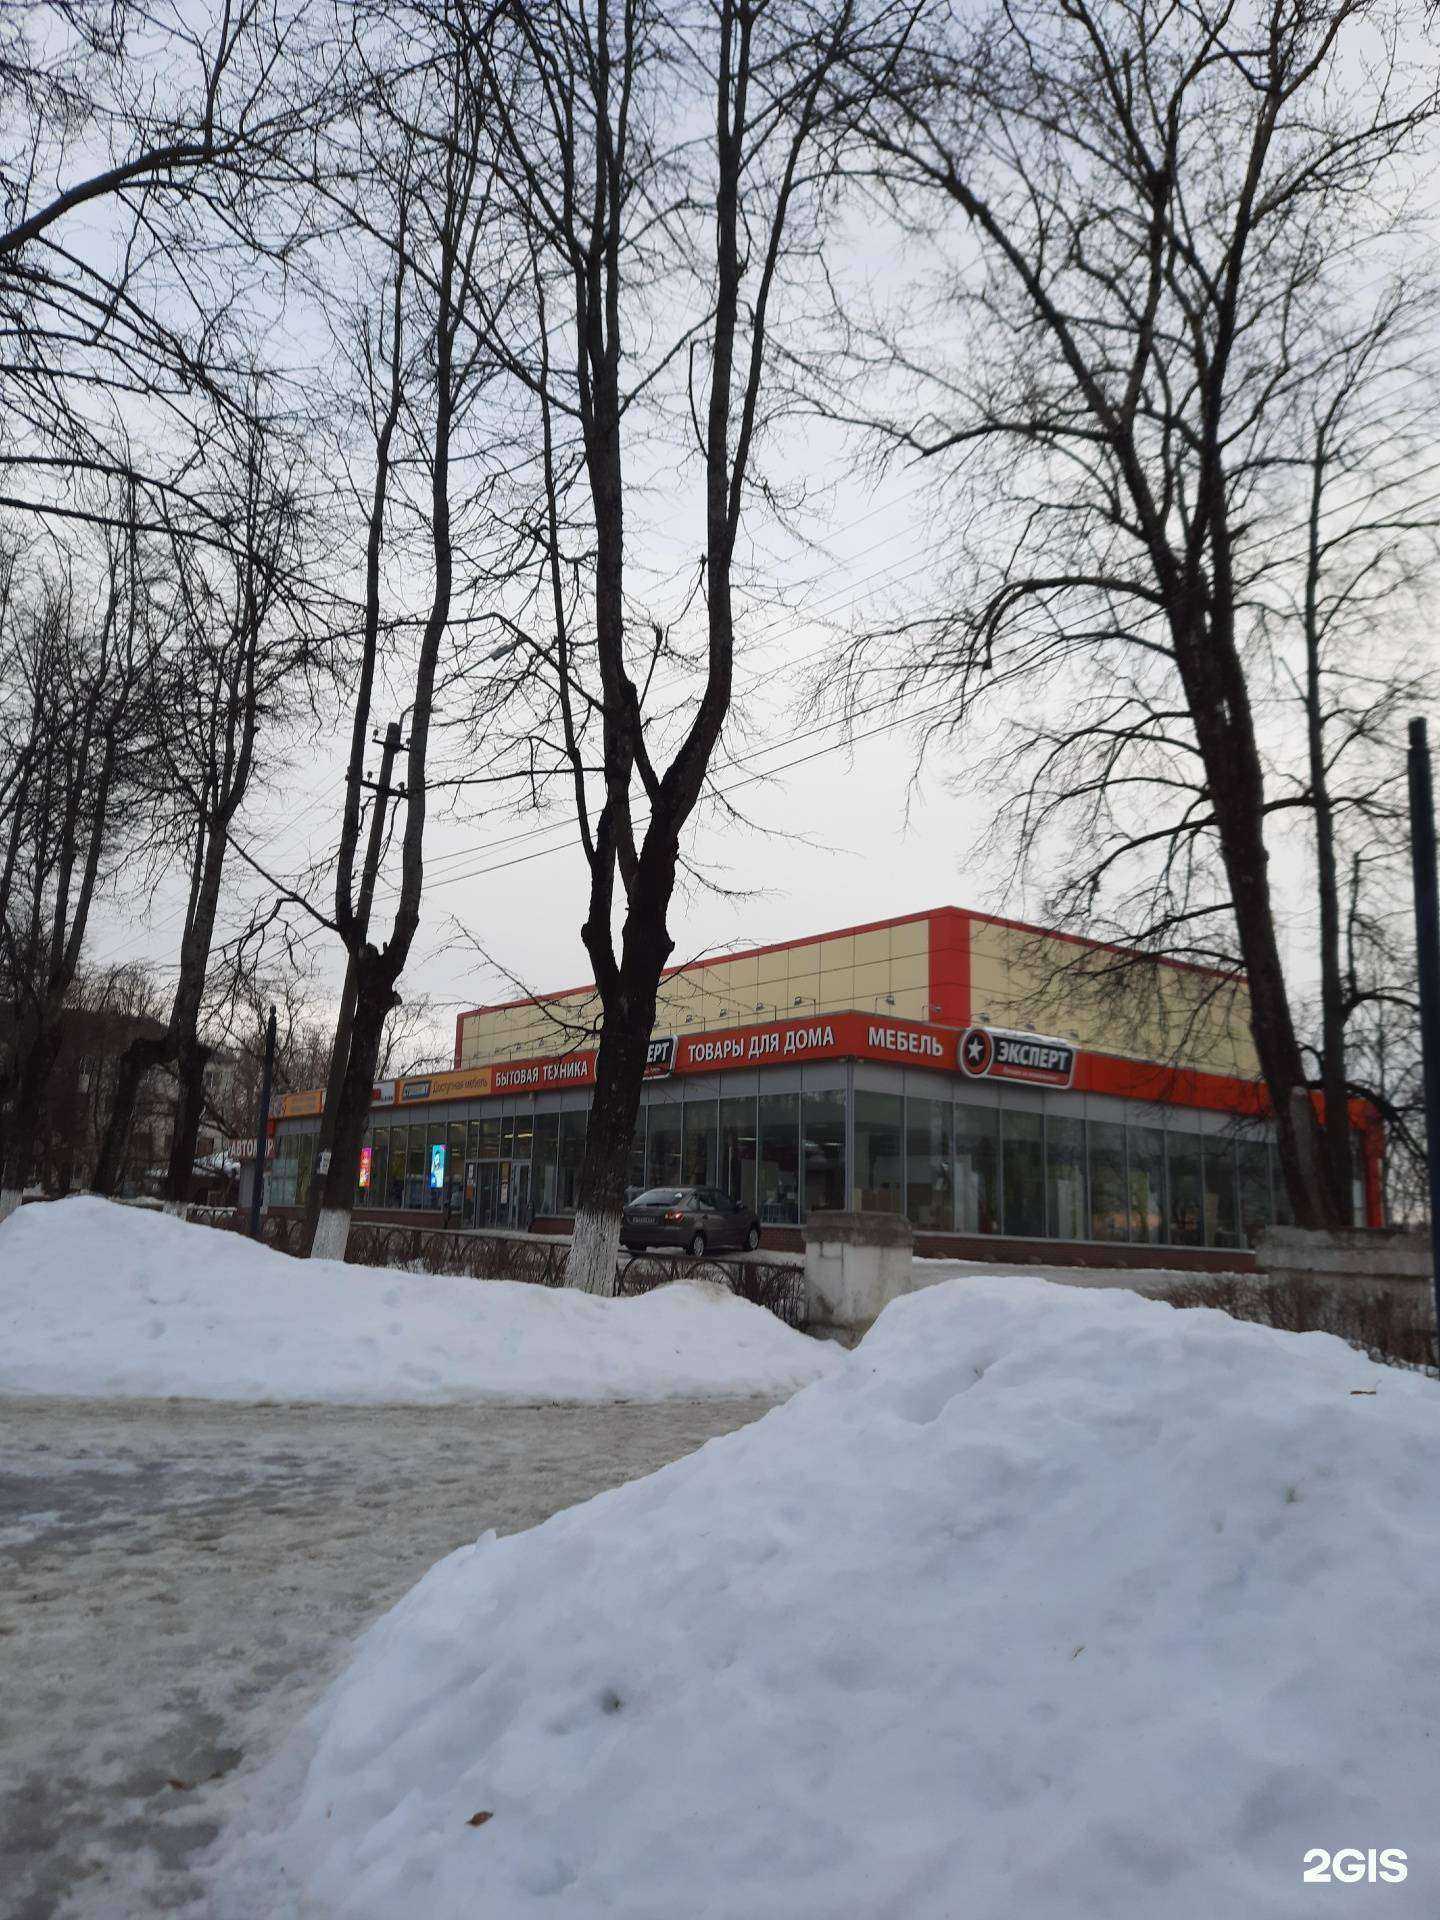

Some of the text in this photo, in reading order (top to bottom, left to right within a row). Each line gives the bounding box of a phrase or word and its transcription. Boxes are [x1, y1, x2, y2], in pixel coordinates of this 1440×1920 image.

[646, 1041, 670, 1063] ЕРТ
[688, 1025, 835, 1063] ТОВАРЫ ДЛЯ ДОМА
[868, 1026, 943, 1057] МЕБЕЛЬ
[997, 1041, 1069, 1071] ЭКСПЕРТ
[495, 1060, 588, 1087] БЫТОВАЯ ТЕХНИКА
[230, 1138, 275, 1157] АВТОР
